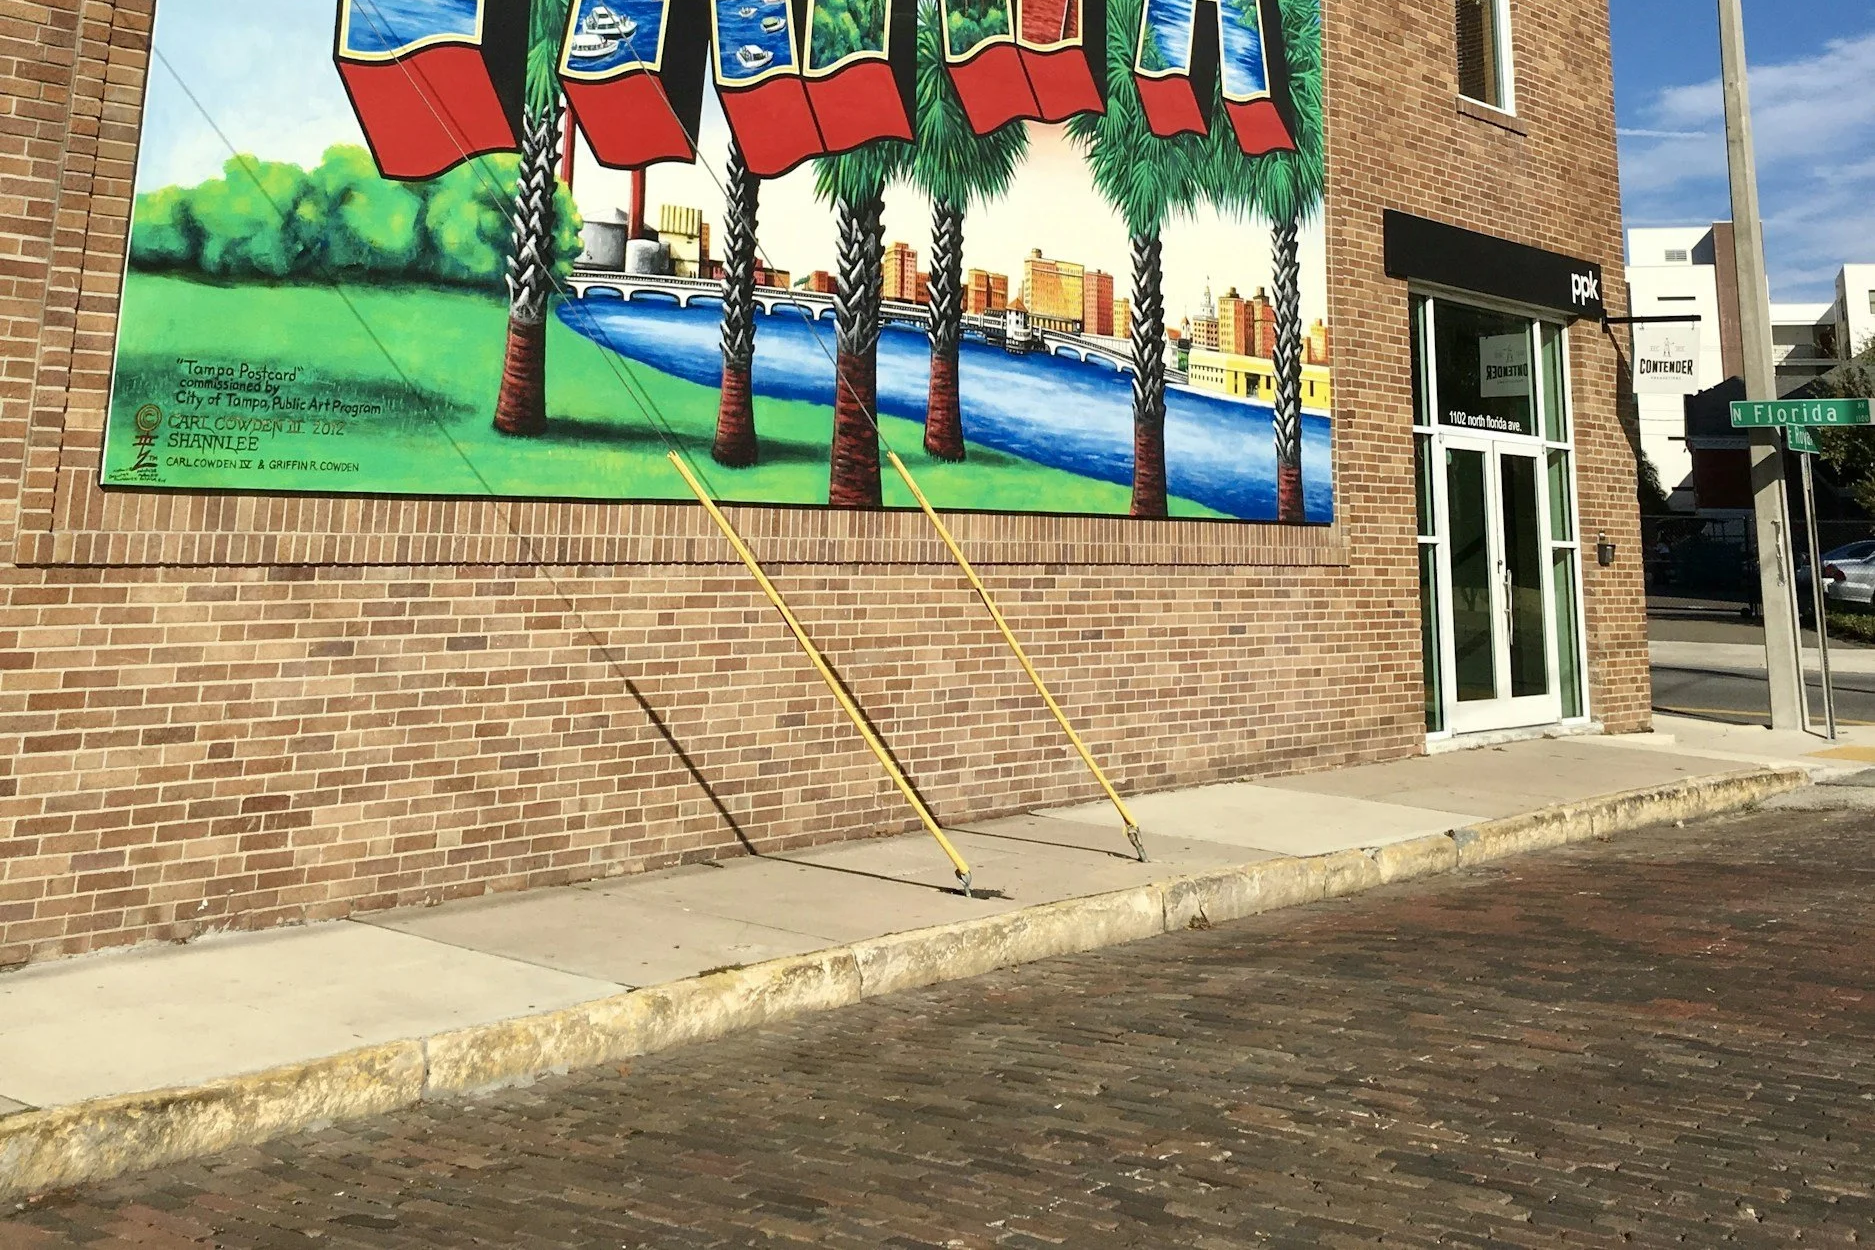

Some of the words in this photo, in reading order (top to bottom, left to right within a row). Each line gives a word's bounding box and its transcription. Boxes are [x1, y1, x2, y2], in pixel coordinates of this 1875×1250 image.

[1571, 270, 1600, 306] ppk
[1640, 358, 1693, 376] CONTENDER
[180, 379, 261, 393] commissioned
[265, 380, 281, 397] by
[175, 390, 204, 411] City
[207, 392, 223, 407] of
[272, 396, 306, 411] Public
[309, 396, 331, 412] Art
[332, 399, 381, 418] Program
[1732, 407, 1742, 422] N
[1753, 403, 1838, 423] Florida
[167, 412, 215, 434] CARL
[214, 414, 283, 440] COWDEN
[312, 420, 346, 436] 2012
[1449, 410, 1467, 425] 1102
[1467, 414, 1486, 428] north
[1486, 415, 1507, 430] florida
[1507, 420, 1523, 432] ave.
[167, 431, 260, 455] SHANNLEE
[1794, 425, 1814, 449] Roya
[166, 455, 193, 468] CARL
[193, 456, 237, 469] COWDEN
[240, 459, 253, 469] IV
[269, 459, 308, 471] GRIFFIN
[320, 461, 360, 472] COWDEN
